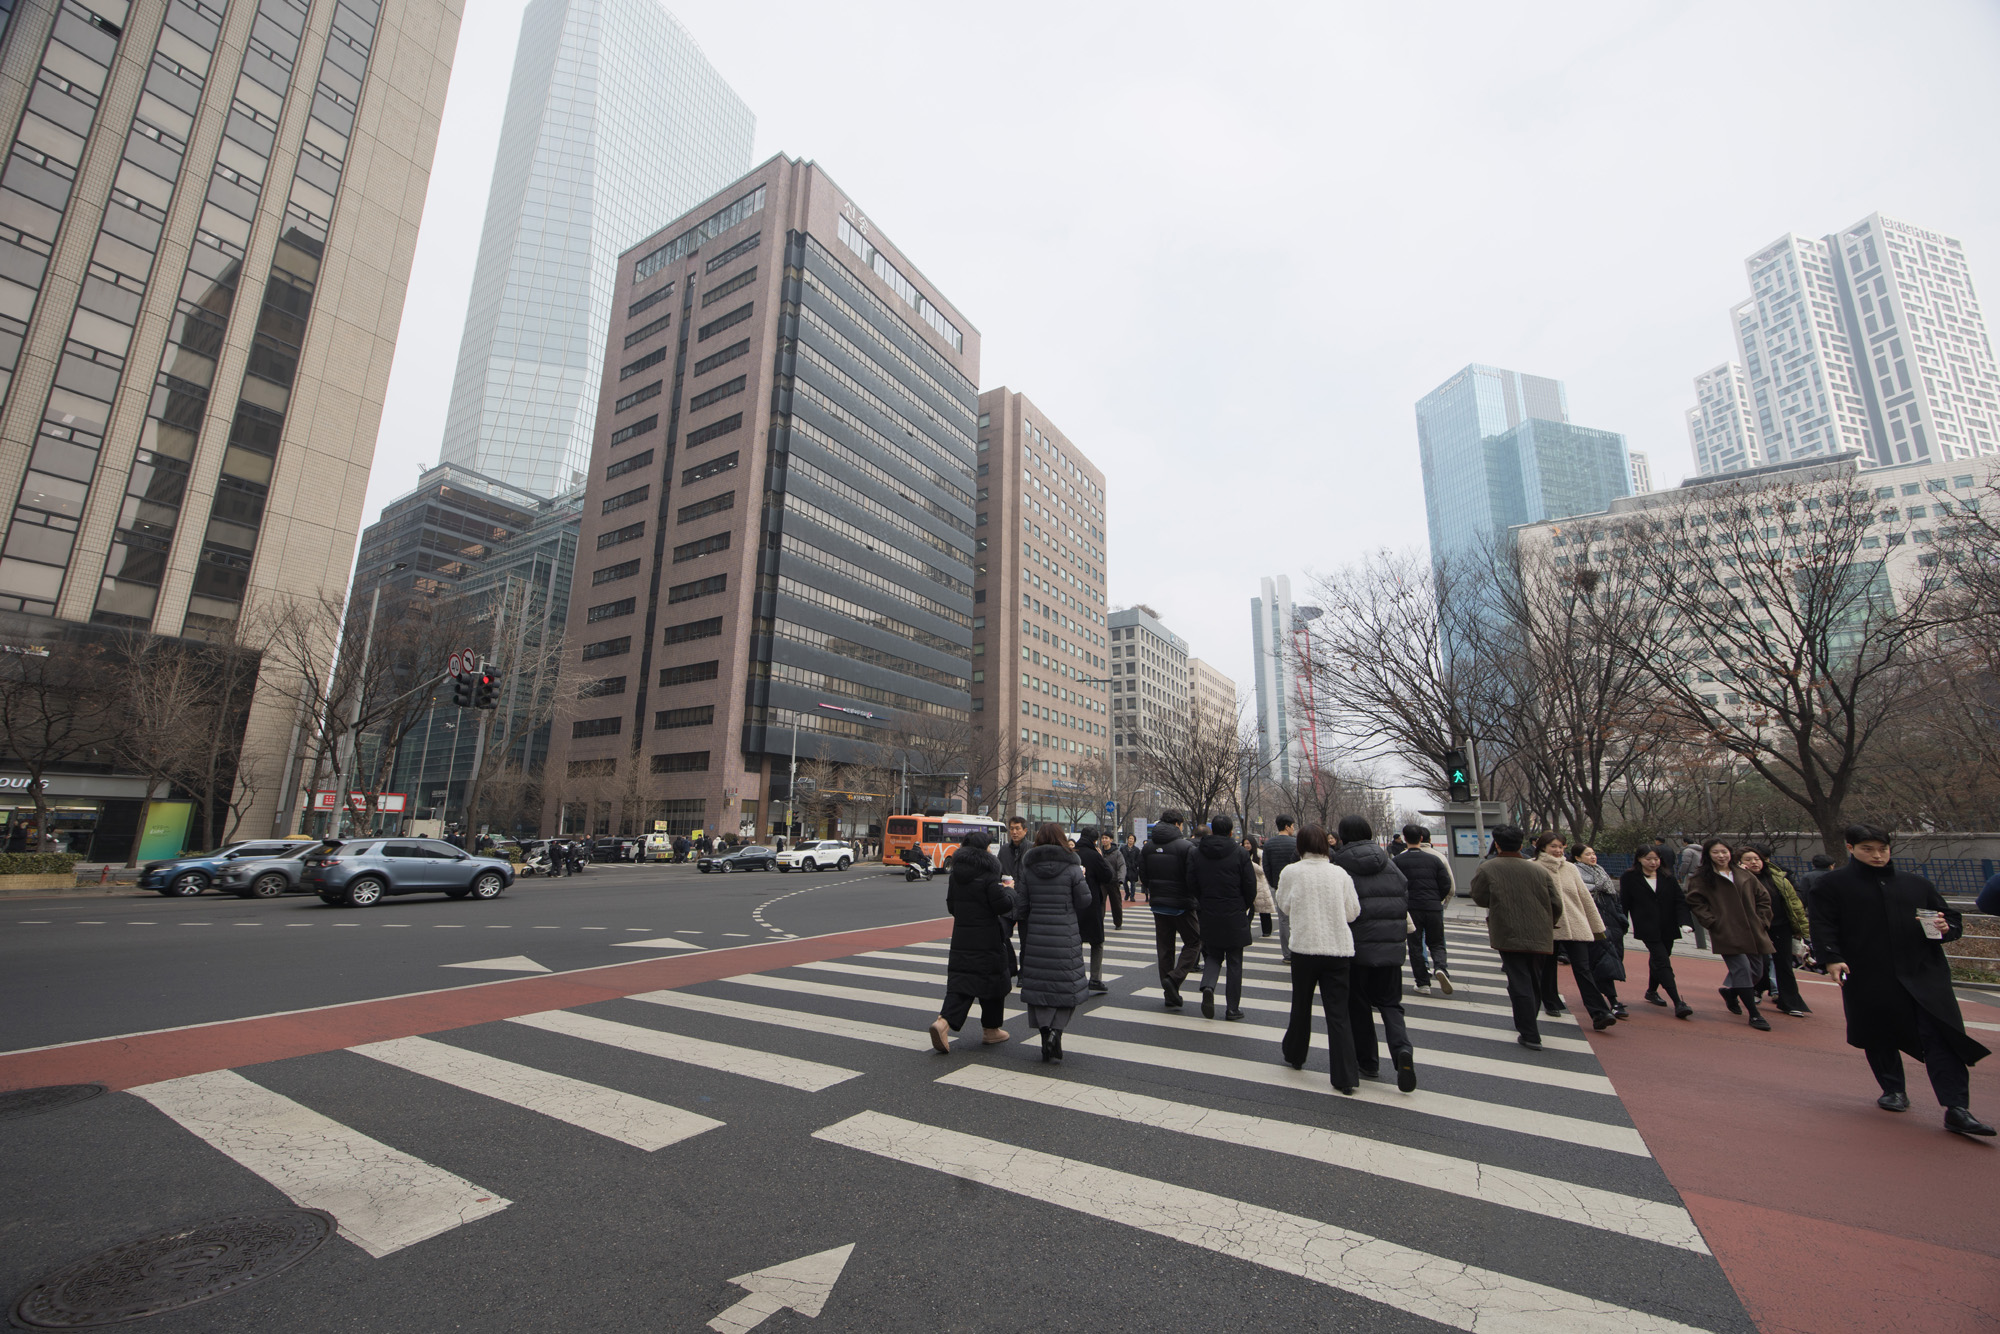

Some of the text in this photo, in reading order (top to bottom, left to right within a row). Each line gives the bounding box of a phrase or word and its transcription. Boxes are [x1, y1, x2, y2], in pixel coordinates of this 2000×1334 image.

[843, 201, 870, 235] 신송
[1882, 216, 1945, 245] BRIGHTEN
[451, 660, 459, 672] 40
